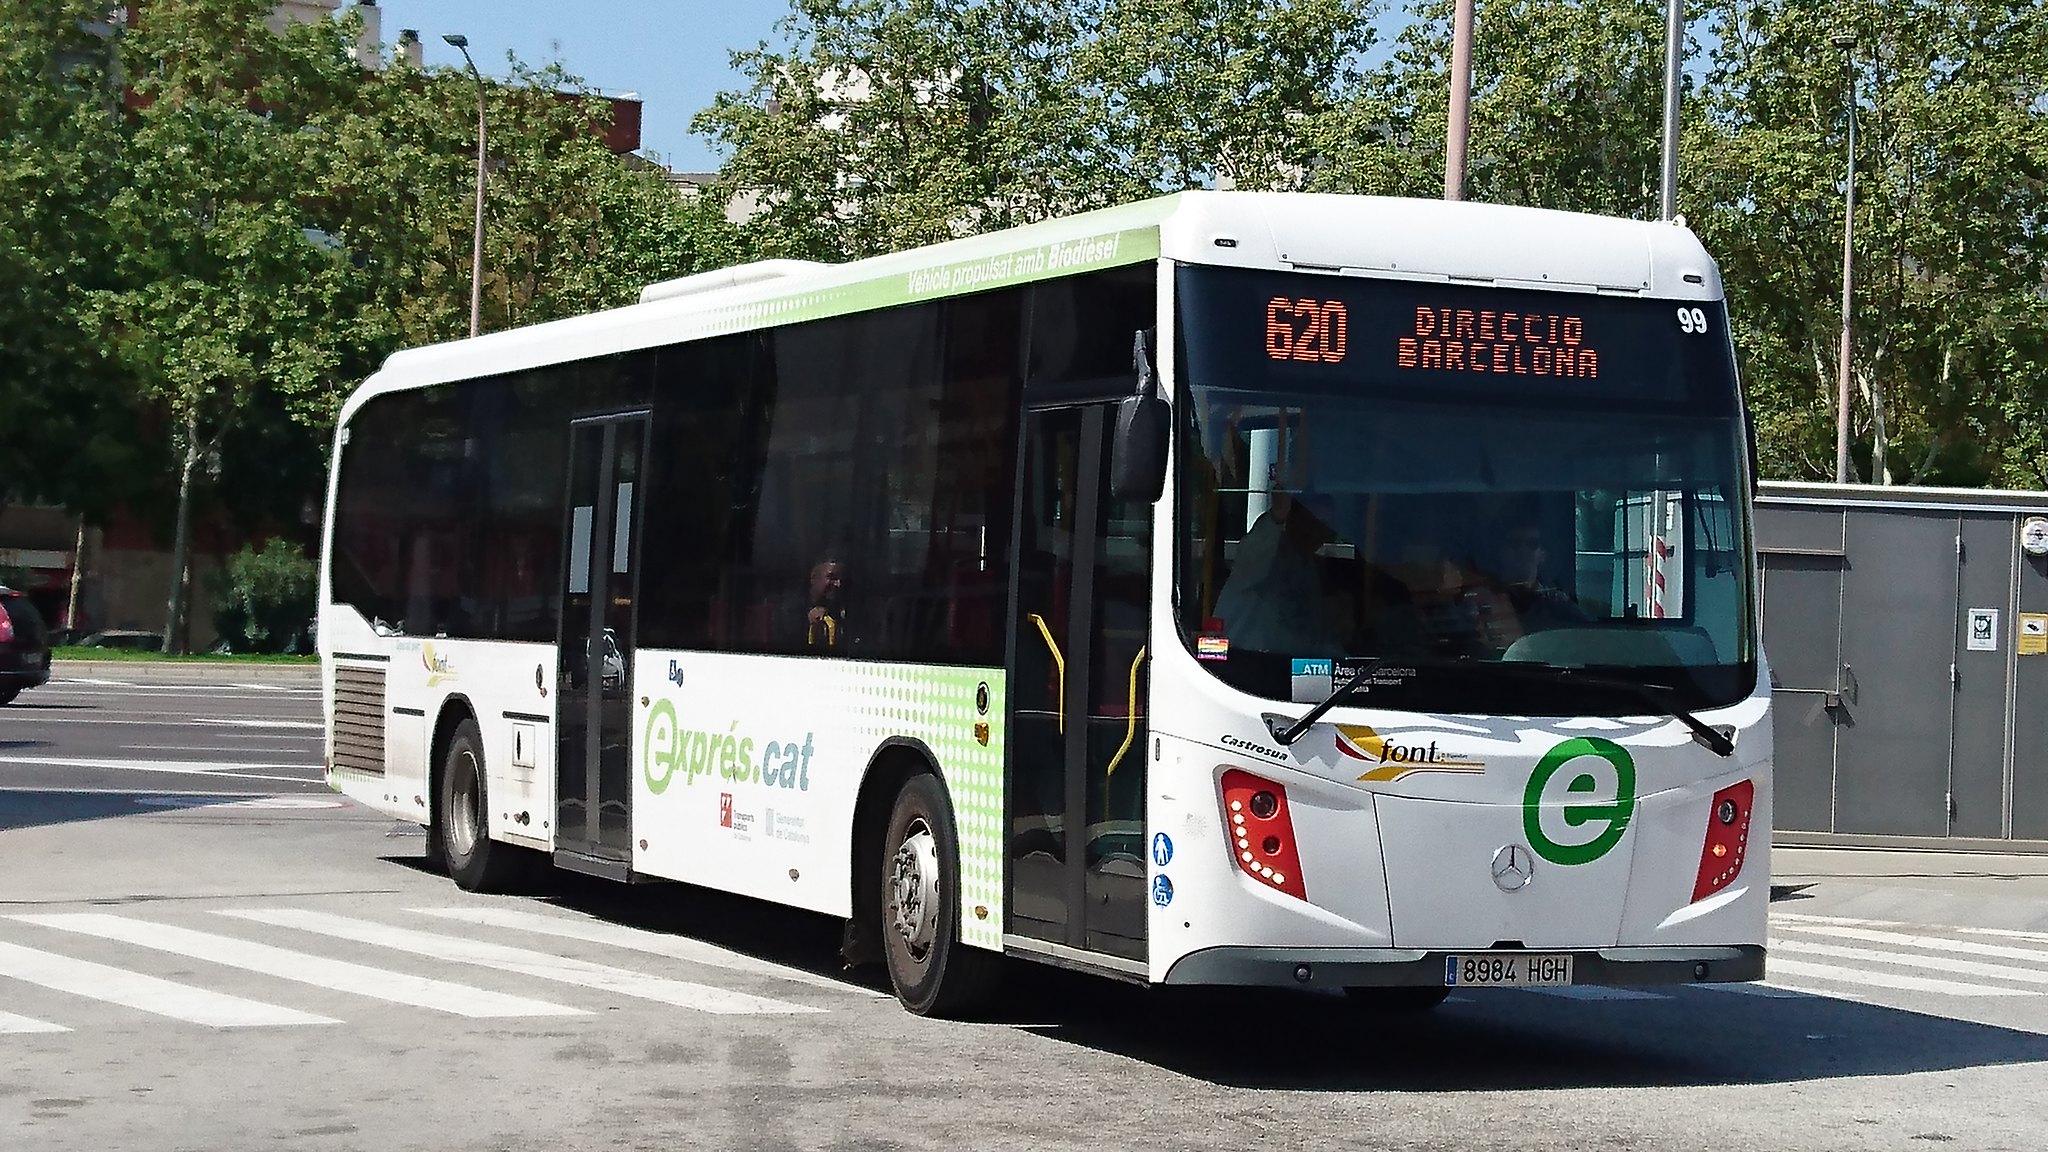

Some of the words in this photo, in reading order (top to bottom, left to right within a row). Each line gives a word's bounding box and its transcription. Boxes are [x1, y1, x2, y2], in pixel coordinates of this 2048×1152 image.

[907, 271, 950, 294] Vehicle
[951, 255, 1012, 290] propulsat
[1015, 248, 1043, 275] amb
[1266, 296, 1347, 363] 620
[1416, 306, 1582, 345] DIRECCIO
[1677, 308, 1707, 333] 99
[1398, 337, 1598, 378] BARCELONA
[1303, 664, 1328, 675] ATM
[644, 698, 814, 795] exprés.cat
[1220, 734, 1288, 761] Castrosua
[1464, 959, 1516, 982] 8984
[1527, 959, 1567, 982] HGH
